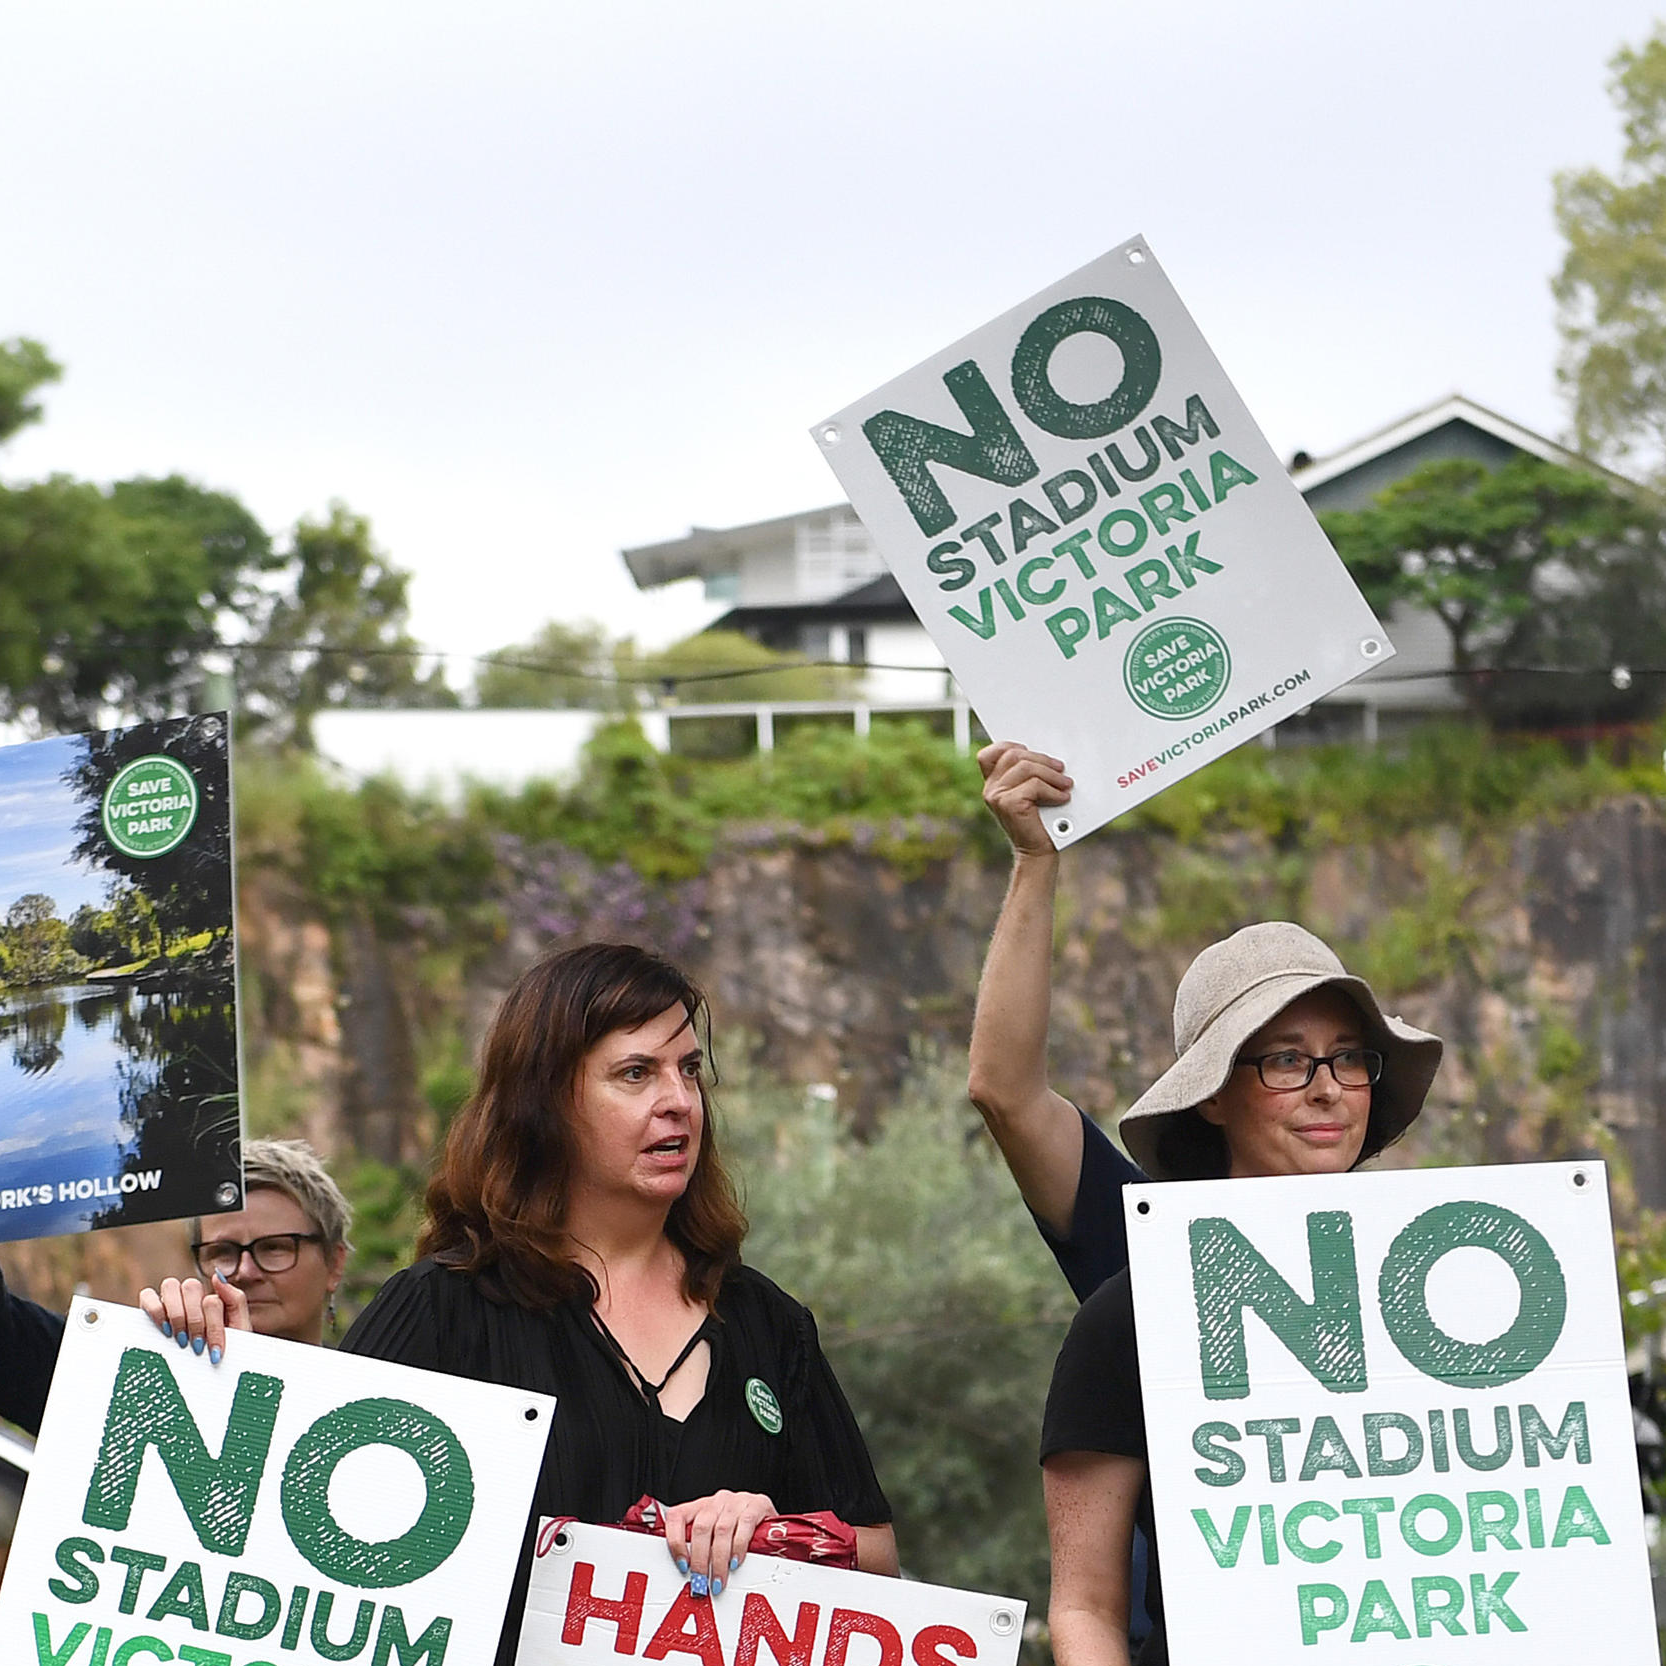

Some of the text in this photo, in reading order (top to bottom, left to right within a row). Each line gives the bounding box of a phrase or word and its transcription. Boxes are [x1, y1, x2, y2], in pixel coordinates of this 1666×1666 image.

[862, 296, 1162, 538] NO
[927, 394, 1220, 592] STADIUM
[948, 450, 1258, 640] VICTORIA
[1045, 530, 1223, 659] PARK
[1134, 642, 1219, 694] VICTORIA
[1144, 635, 1190, 668] SAVE
[1163, 668, 1212, 703] PARK
[1117, 669, 1311, 788] SAVEVICTORIAPARK.COM
[110, 794, 191, 818] VICTORIA
[128, 777, 172, 797] SAVE
[128, 816, 172, 835] PARK
[59, 1170, 162, 1201] HOLLOW
[1188, 1200, 1568, 1400] NO
[82, 1346, 474, 1589] NO
[1192, 1401, 1592, 1486] STADIUM
[1190, 1485, 1611, 1569] VICTORIA
[1297, 1571, 1528, 1646] PARK
